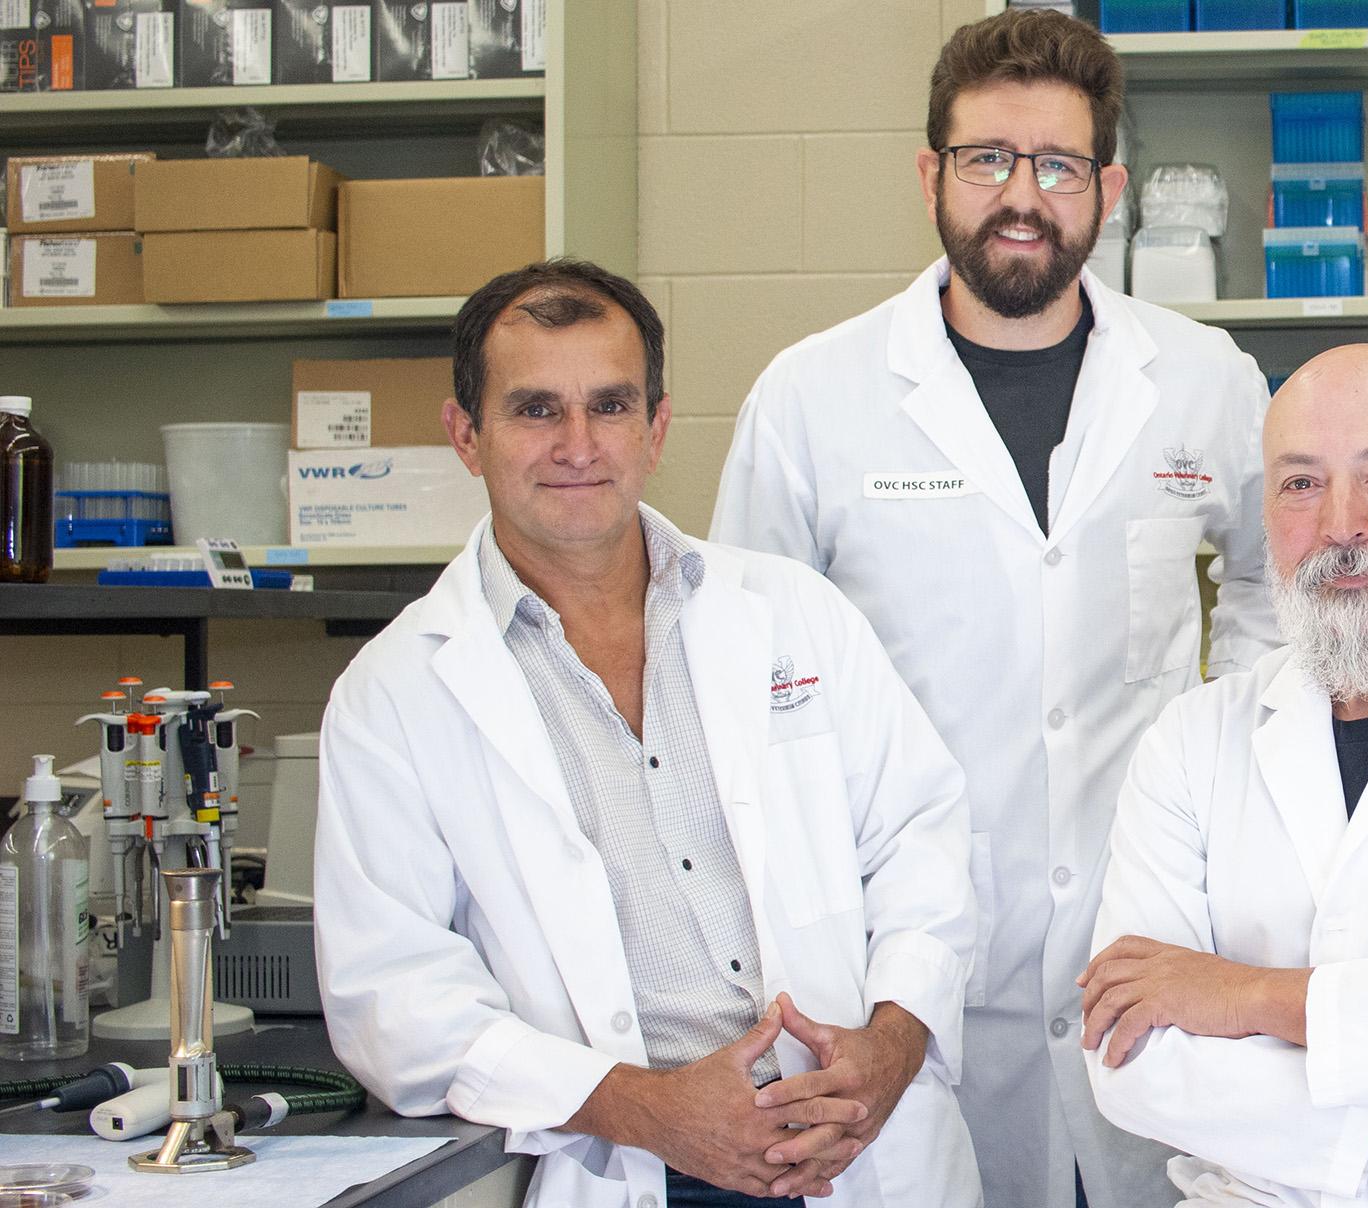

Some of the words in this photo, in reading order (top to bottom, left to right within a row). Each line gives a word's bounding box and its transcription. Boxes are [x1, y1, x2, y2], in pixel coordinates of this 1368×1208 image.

[18, 39, 37, 89] TIPS
[298, 467, 346, 479] VWR
[874, 481, 899, 490] OVC
[902, 481, 926, 490] HSC
[929, 480, 964, 490] STAFF
